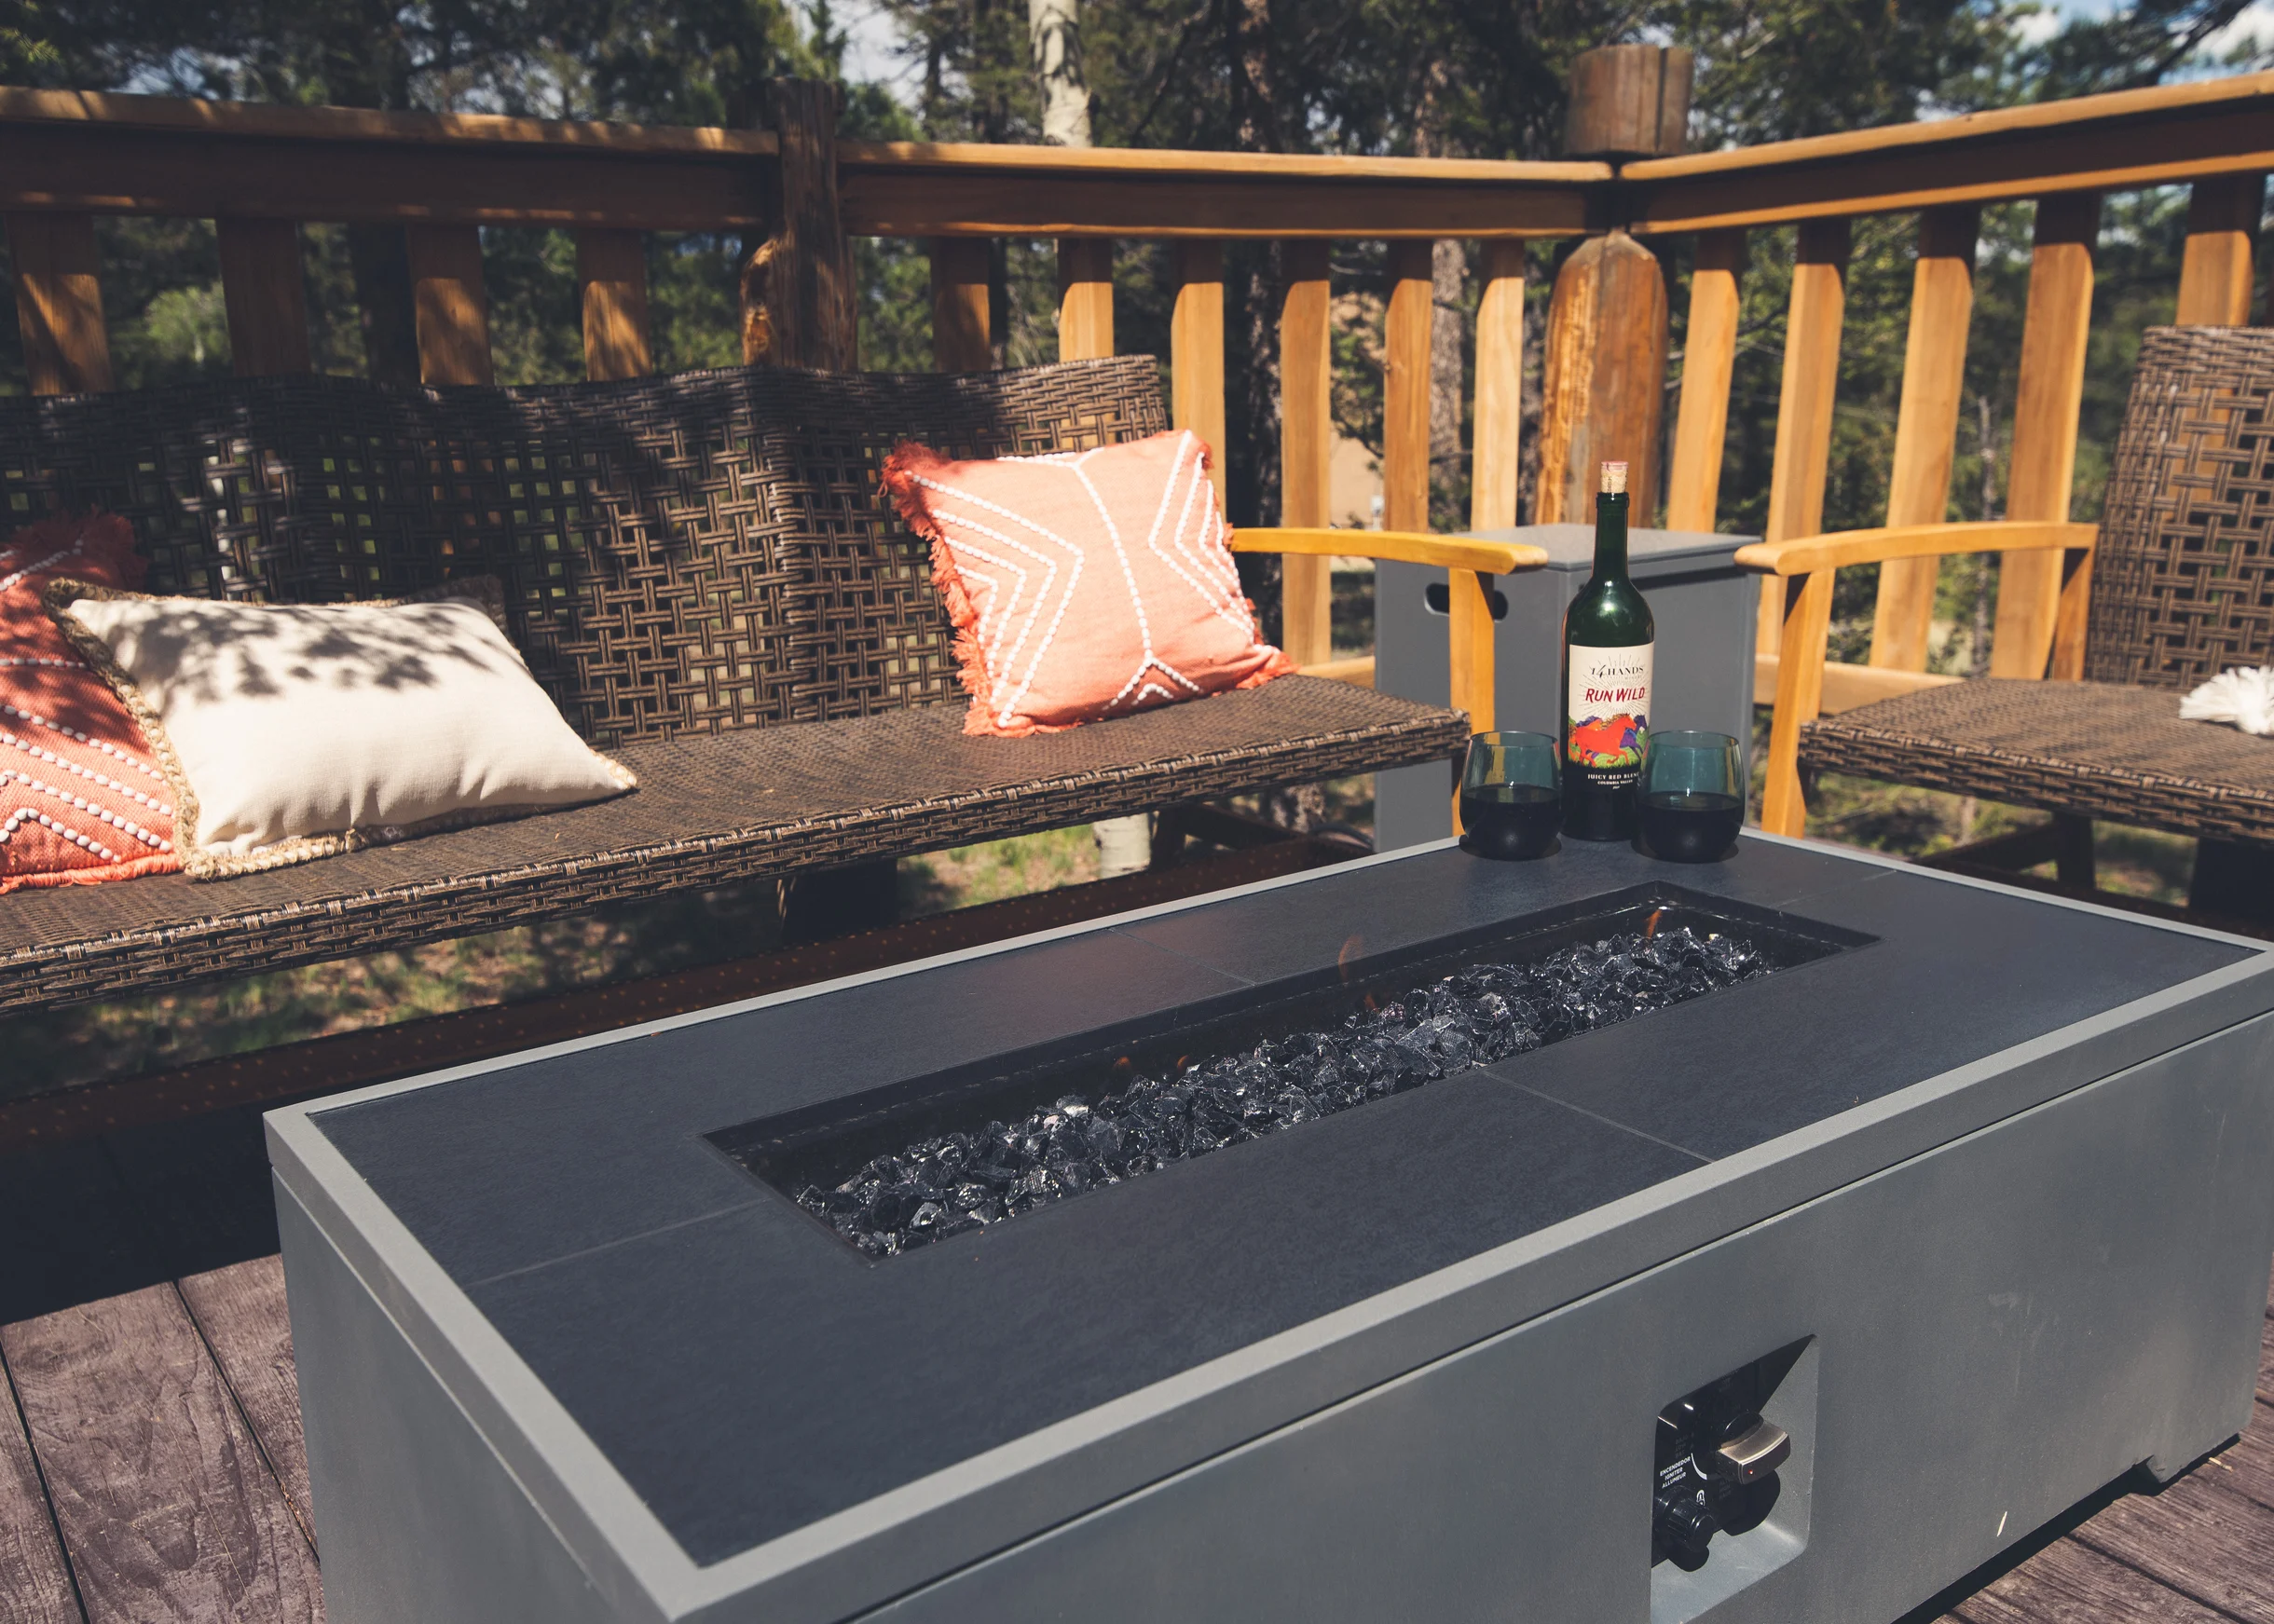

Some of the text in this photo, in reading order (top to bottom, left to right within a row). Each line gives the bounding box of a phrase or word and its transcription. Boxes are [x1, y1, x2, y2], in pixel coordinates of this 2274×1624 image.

[1591, 664, 1644, 678] 14 HANDS
[1585, 686, 1646, 703] RUN WILD
[1660, 1455, 1692, 1477] ENCENDEDOR
[1664, 1467, 1683, 1481] IGNITER
[1662, 1471, 1687, 1489] ALLUMEUR
